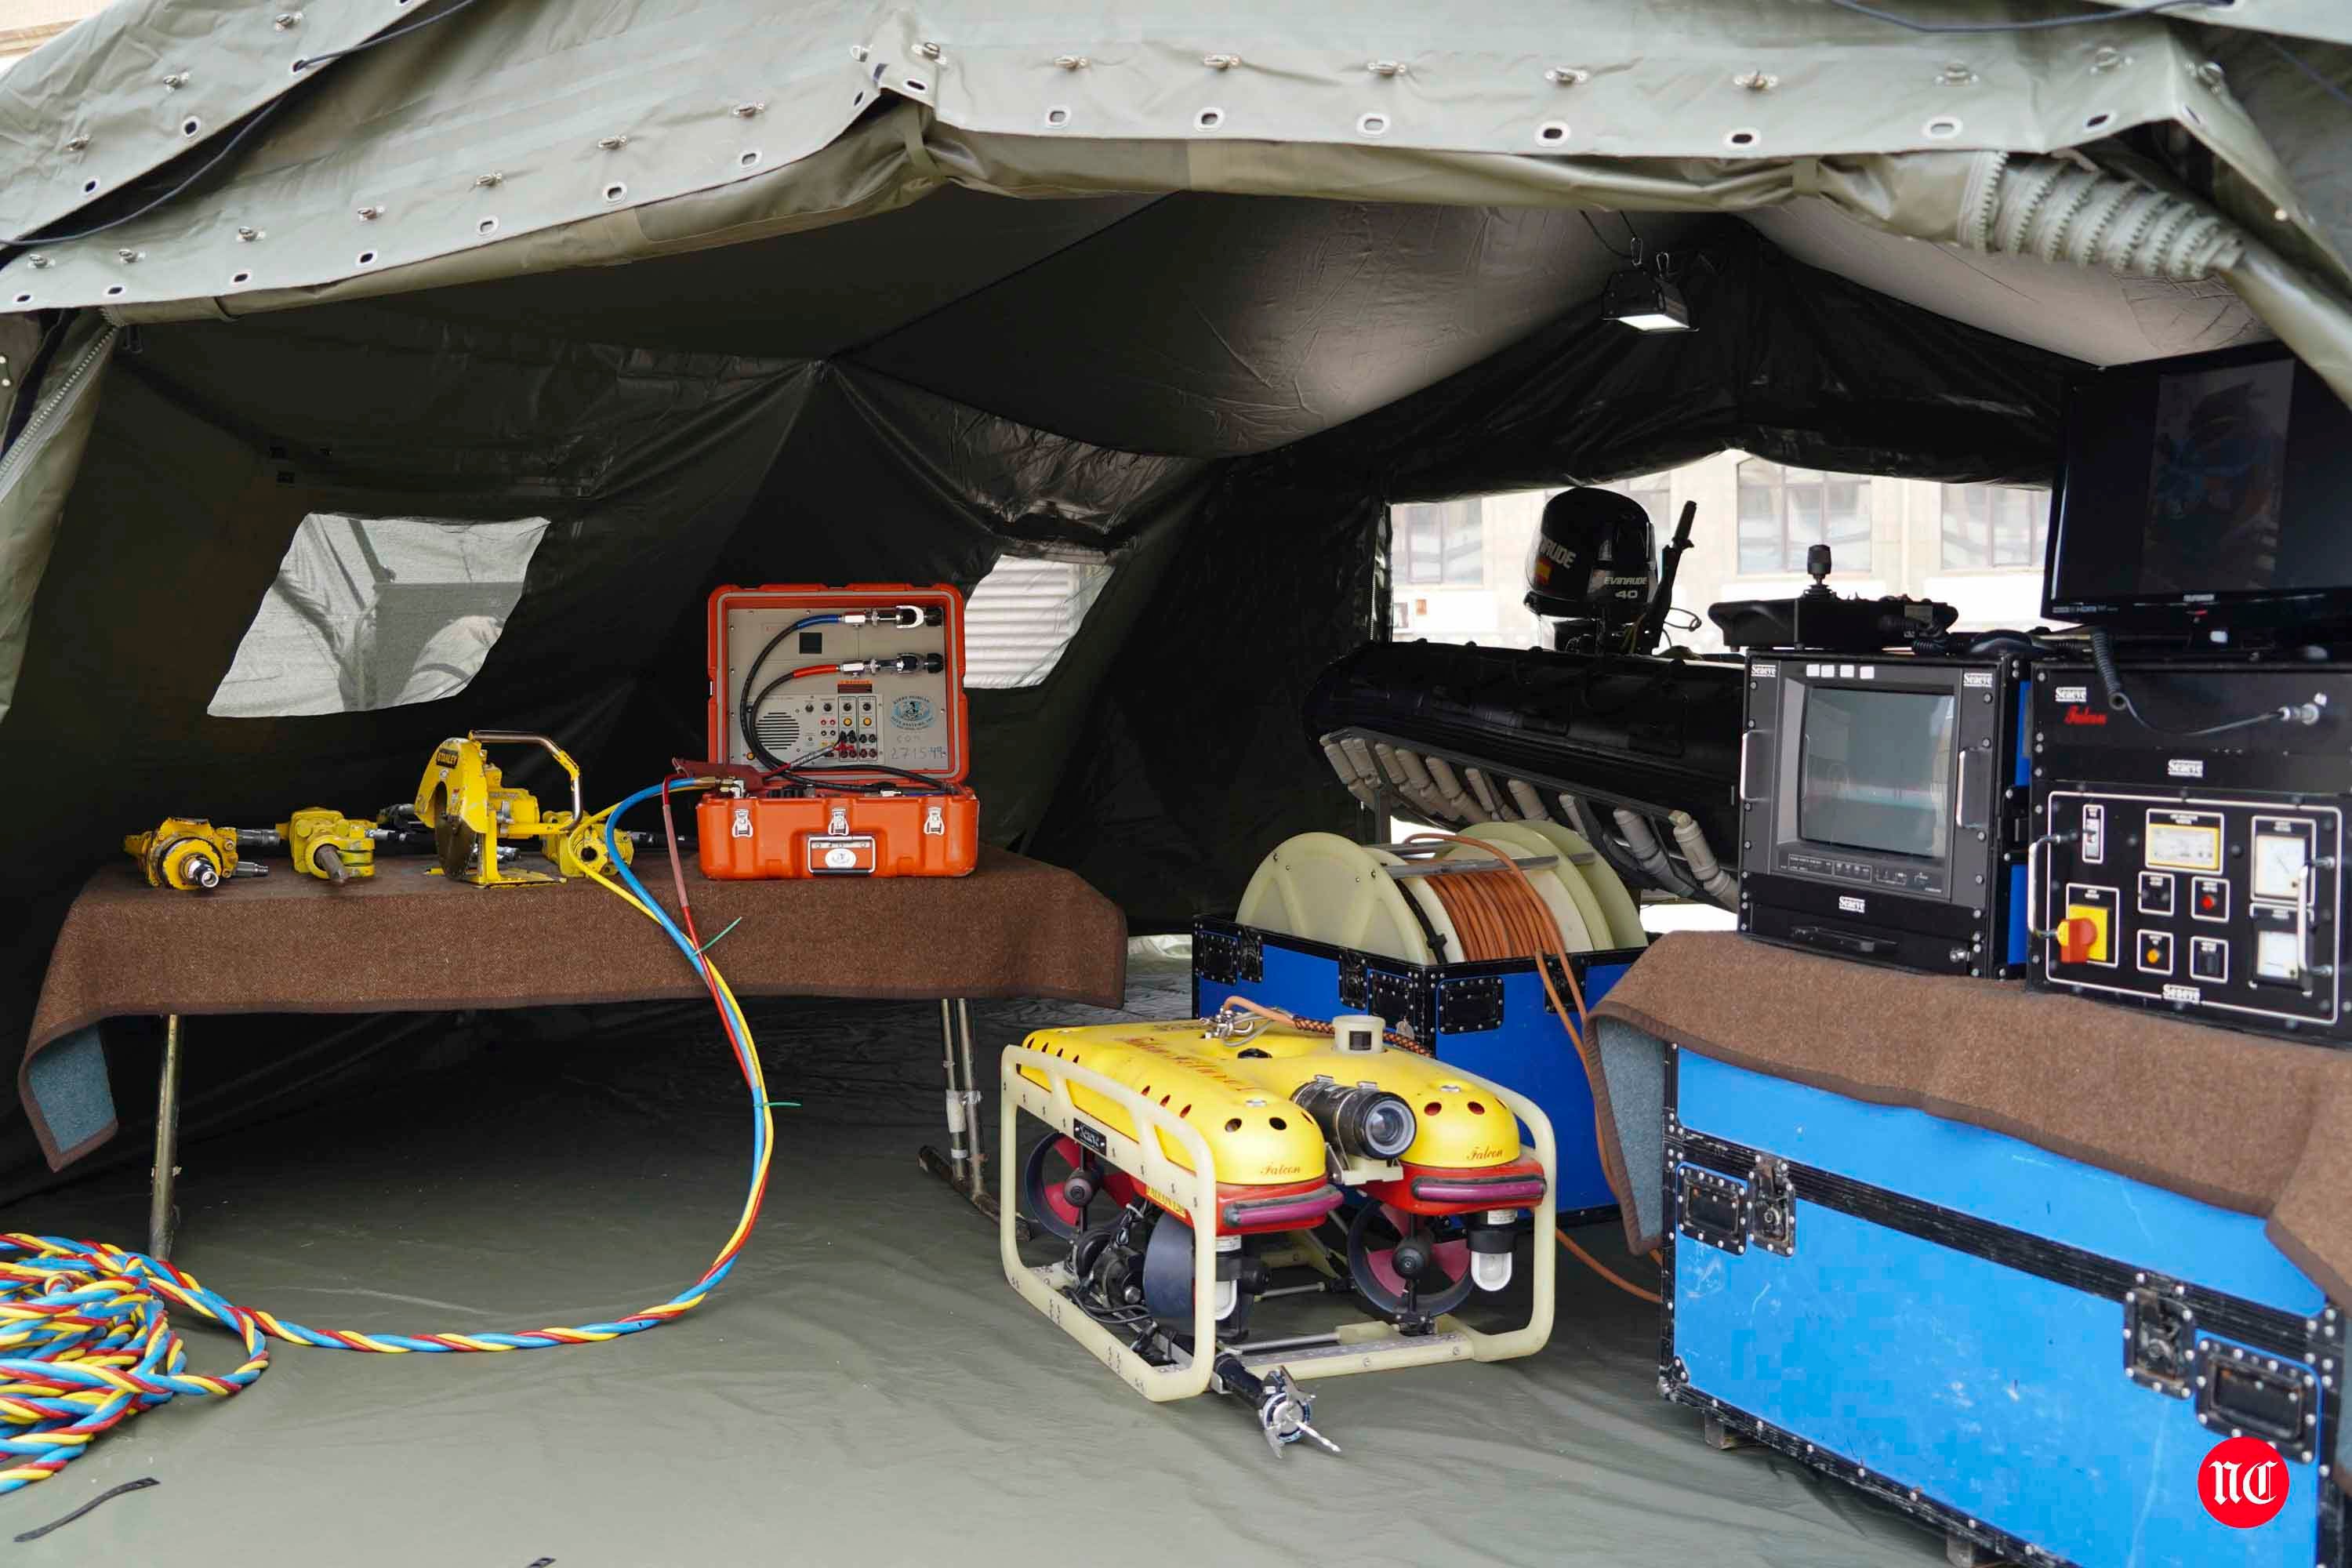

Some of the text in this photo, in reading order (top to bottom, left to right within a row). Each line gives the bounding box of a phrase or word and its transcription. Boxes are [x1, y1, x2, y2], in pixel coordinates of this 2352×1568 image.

[1604, 576, 1647, 585] EVINRUDE
[1615, 590, 1638, 599] 40
[1467, 1145, 1502, 1160] Falcon
[1260, 1162, 1301, 1175] Falcon
